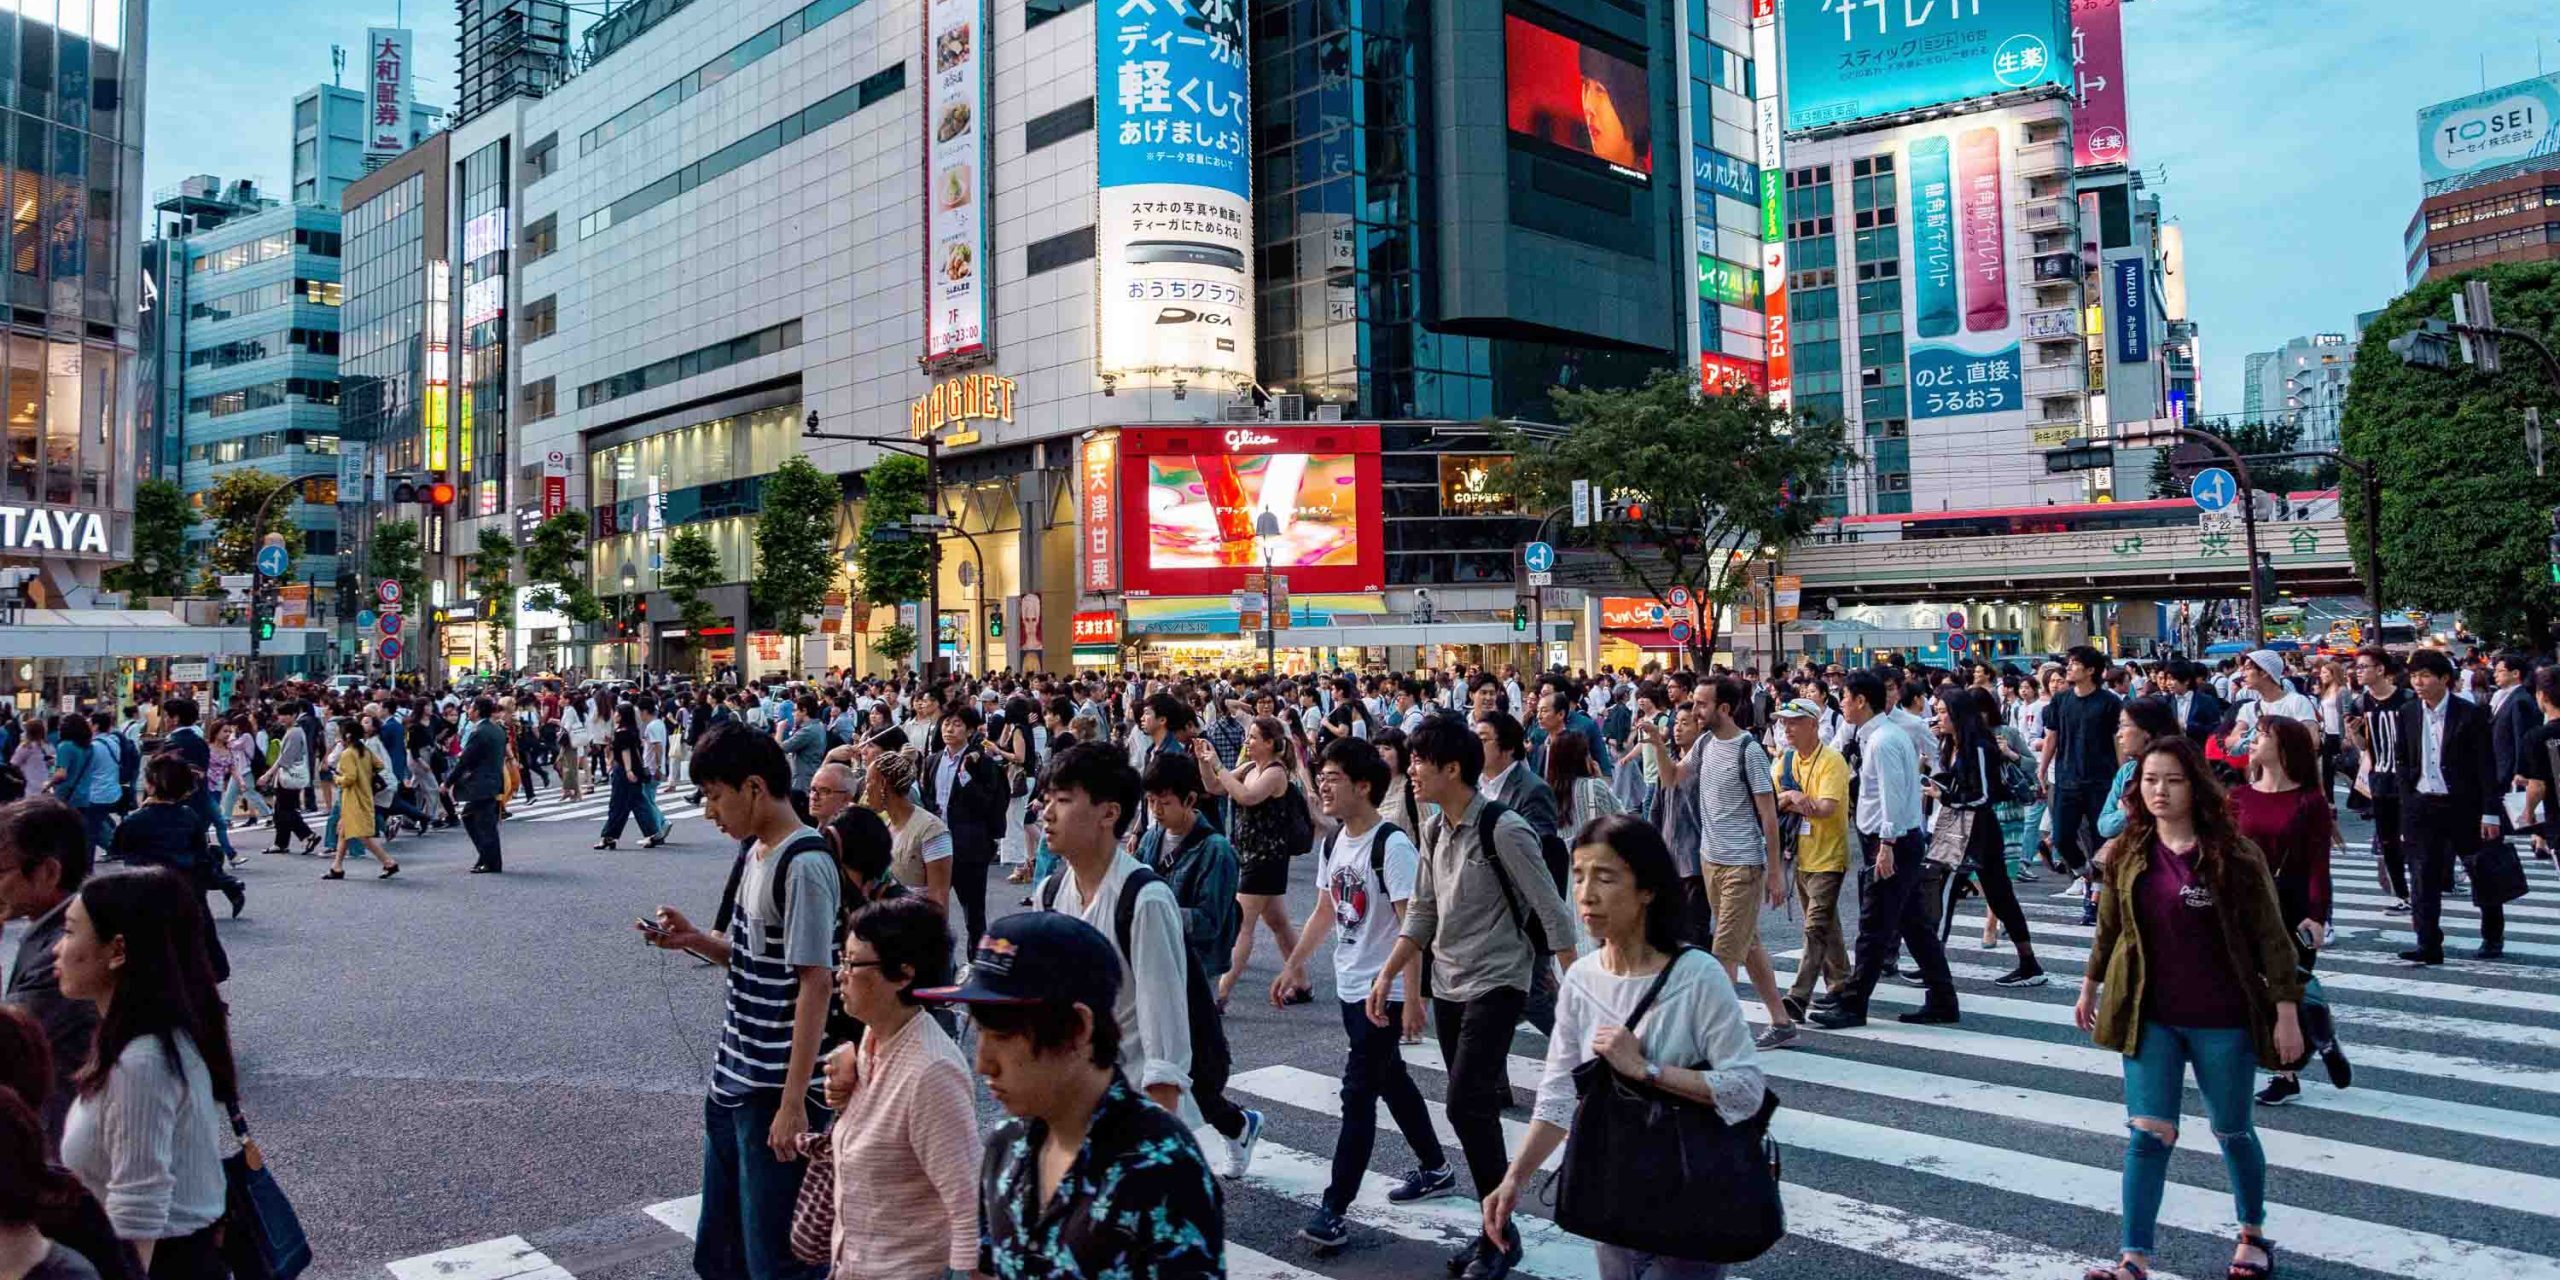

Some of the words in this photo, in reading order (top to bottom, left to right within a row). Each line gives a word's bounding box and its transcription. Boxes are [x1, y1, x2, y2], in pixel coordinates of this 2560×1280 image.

[1117, 22, 1242, 69] ディーガが
[1838, 40, 1917, 69] スティック
[1997, 46, 2043, 74] 生薬
[376, 38, 401, 126] 大和証券
[1117, 60, 1243, 126] 軽くして
[1119, 119, 1244, 157] あげましょう!
[1764, 103, 1775, 167] レオパレス21
[2445, 107, 2532, 144] TOSEI
[2091, 134, 2122, 151] 生薬
[2447, 129, 2534, 158] トーセイ株式会社
[1695, 156, 1753, 195] レオパレス21
[1132, 202, 1241, 224] スマホの写真や動画は
[1132, 218, 1242, 241] ディーガにためられる!
[2125, 266, 2138, 308] MIZUHO
[949, 308, 960, 325] 7F
[1155, 307, 1233, 327] DIGA
[1769, 315, 1786, 358] アコム
[1916, 360, 2019, 388] のど、直接、
[912, 374, 1016, 440] MAGNET
[1926, 387, 2004, 413] うるおう
[1225, 429, 1279, 452] Glico
[2094, 427, 2106, 439] 3F
[1090, 462, 1109, 586] 天津甘栗
[2113, 536, 2143, 554] JR
[1075, 619, 1114, 636] 天津甘栗
